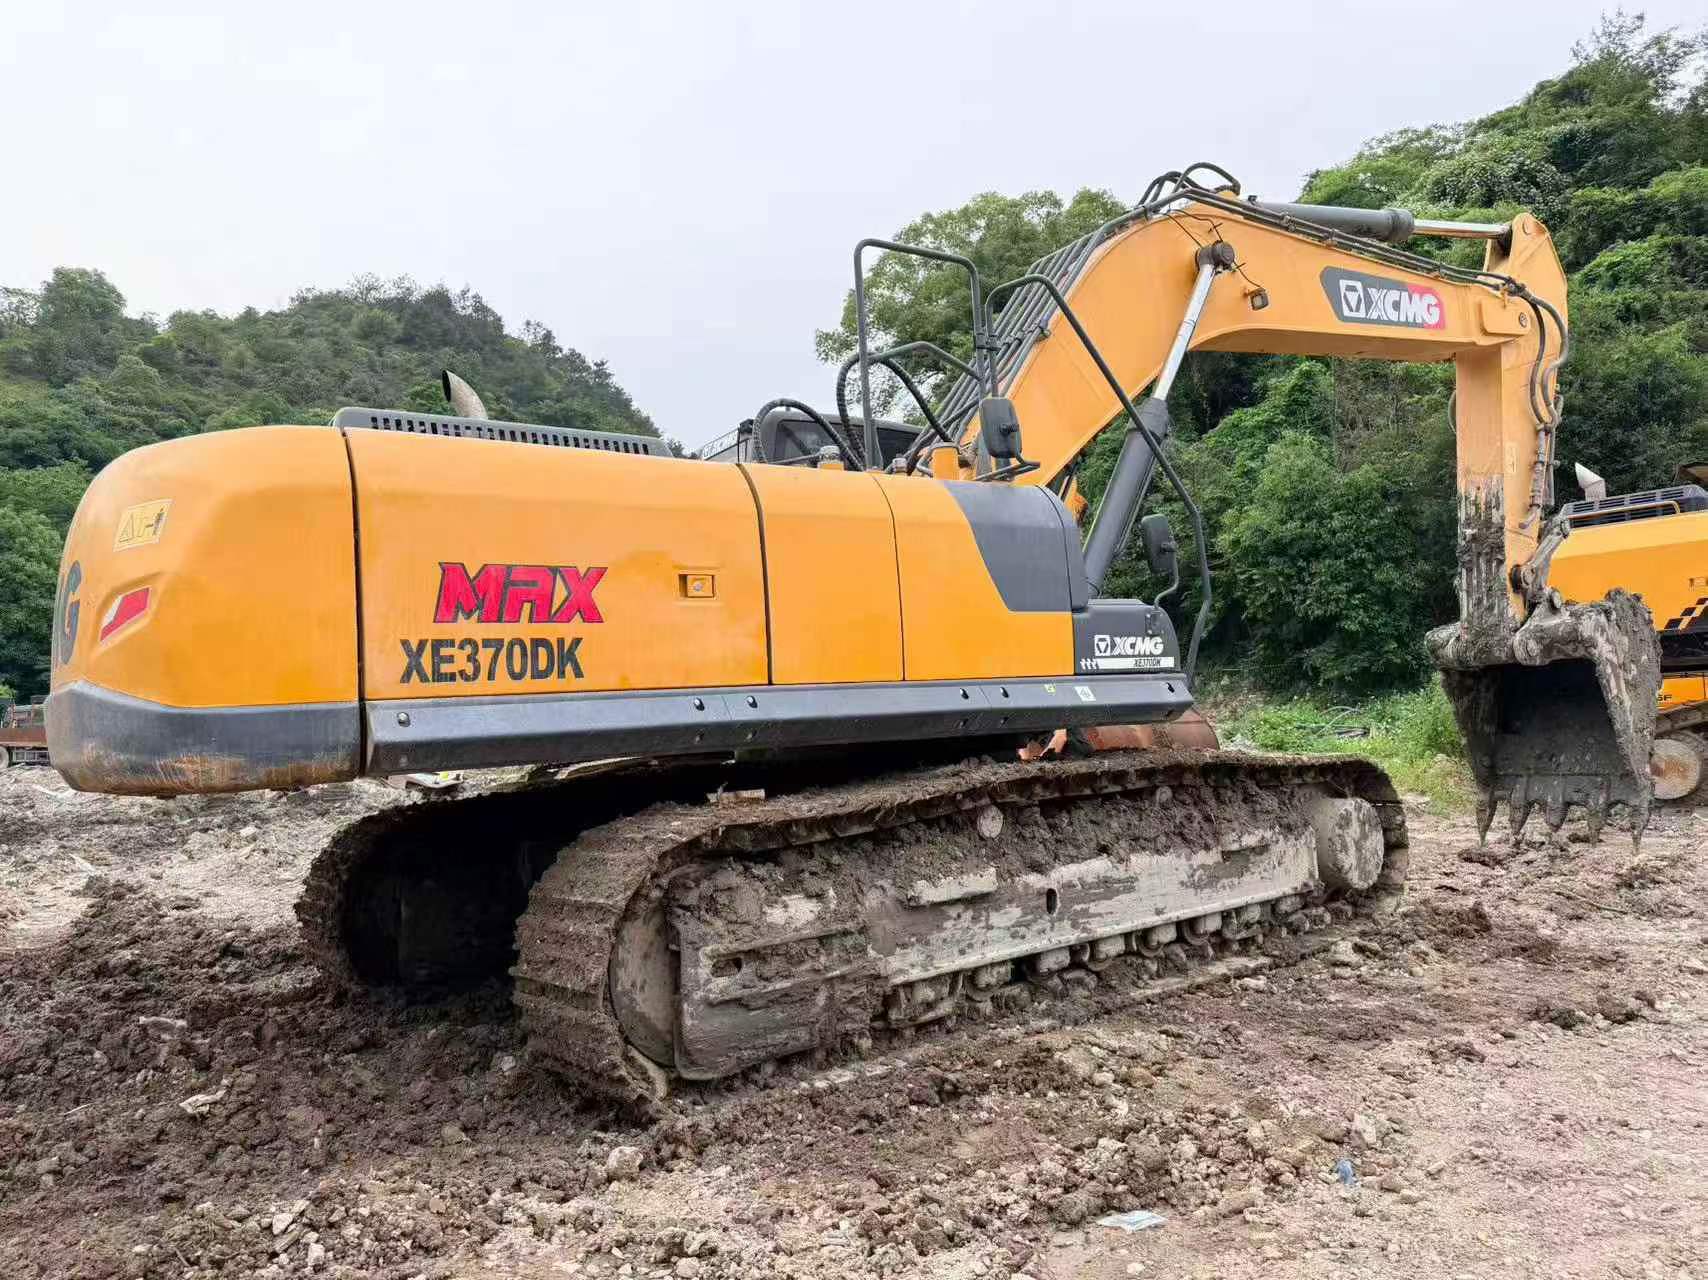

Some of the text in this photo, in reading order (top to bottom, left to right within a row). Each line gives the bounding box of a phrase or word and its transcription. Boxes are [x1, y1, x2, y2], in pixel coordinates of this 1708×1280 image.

[1367, 287, 1440, 325] XCMG
[53, 559, 82, 665] G
[434, 561, 608, 623] MAX
[399, 637, 584, 684] XE370DK
[1112, 636, 1164, 656] XCMG
